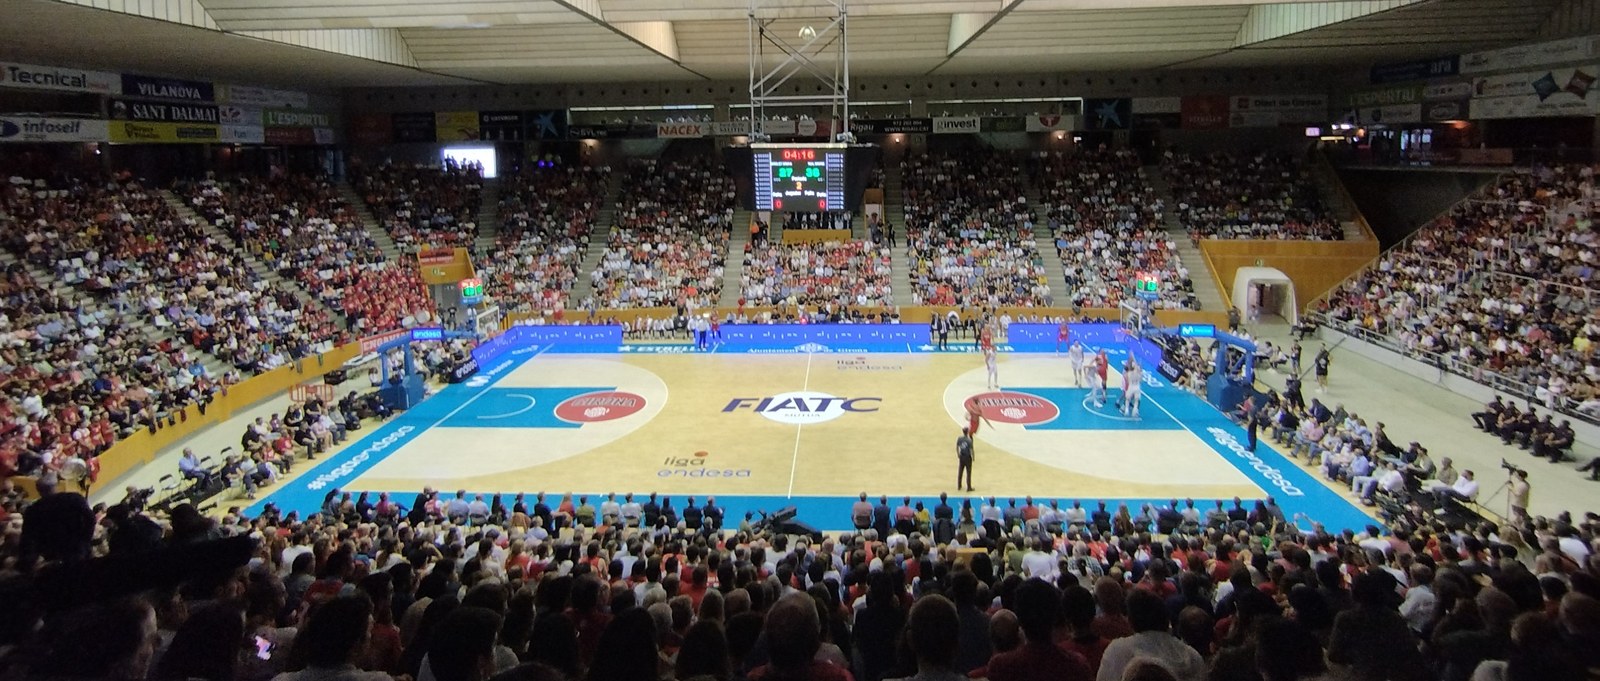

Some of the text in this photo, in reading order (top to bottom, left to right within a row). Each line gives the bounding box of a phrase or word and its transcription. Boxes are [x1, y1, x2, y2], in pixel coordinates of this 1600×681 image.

[8, 66, 87, 88] Tecnical
[137, 82, 201, 100] VILANOVA
[133, 102, 217, 122] SANT DALMAI
[850, 122, 874, 133] Rigau
[937, 118, 977, 129] ginvest
[659, 124, 702, 136] NACEX
[784, 150, 814, 159] 04:16
[796, 181, 802, 190] 2
[413, 330, 442, 338] endesa
[456, 359, 478, 378] endesa
[721, 397, 882, 413] FIATC
[307, 425, 416, 490] #ligaendesa
[664, 456, 705, 467] liga
[1206, 426, 1305, 497] #ligaendesa
[657, 468, 751, 477] endesa
